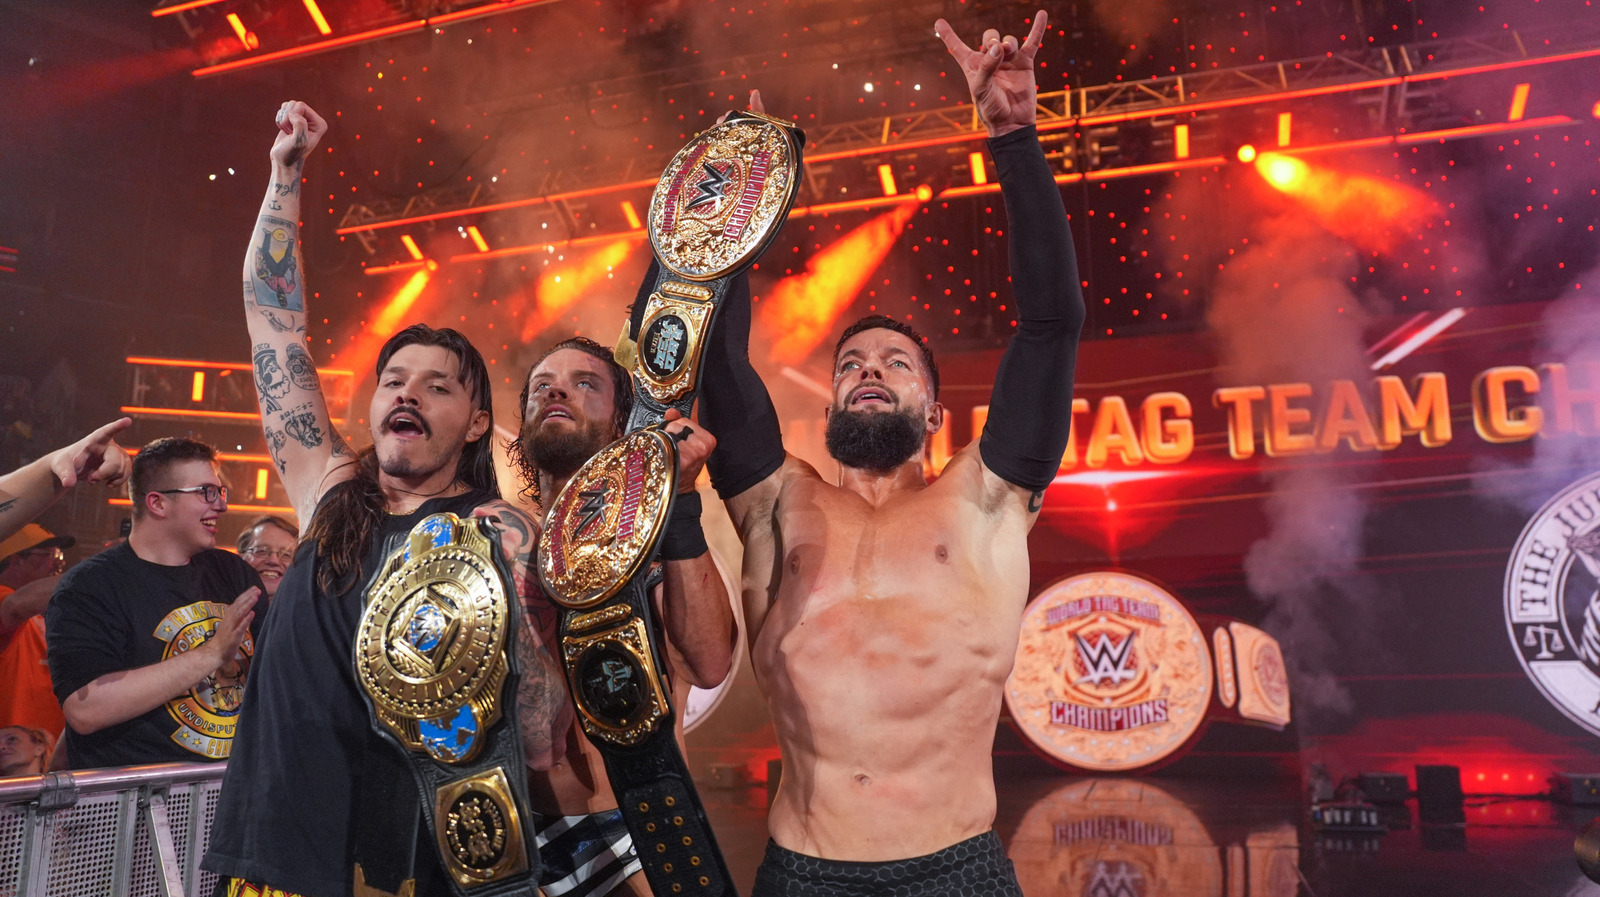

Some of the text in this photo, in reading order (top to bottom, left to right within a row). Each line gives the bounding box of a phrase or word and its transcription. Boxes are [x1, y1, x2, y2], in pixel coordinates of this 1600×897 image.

[1212, 372, 1452, 460] TEAM
[1520, 489, 1600, 611] THE JU
[169, 609, 189, 630] THE
[185, 603, 214, 621] LAST
[178, 703, 237, 734] UNDISPU
[1051, 700, 1169, 730] CHAMPIONS
[207, 738, 230, 756] CHA
